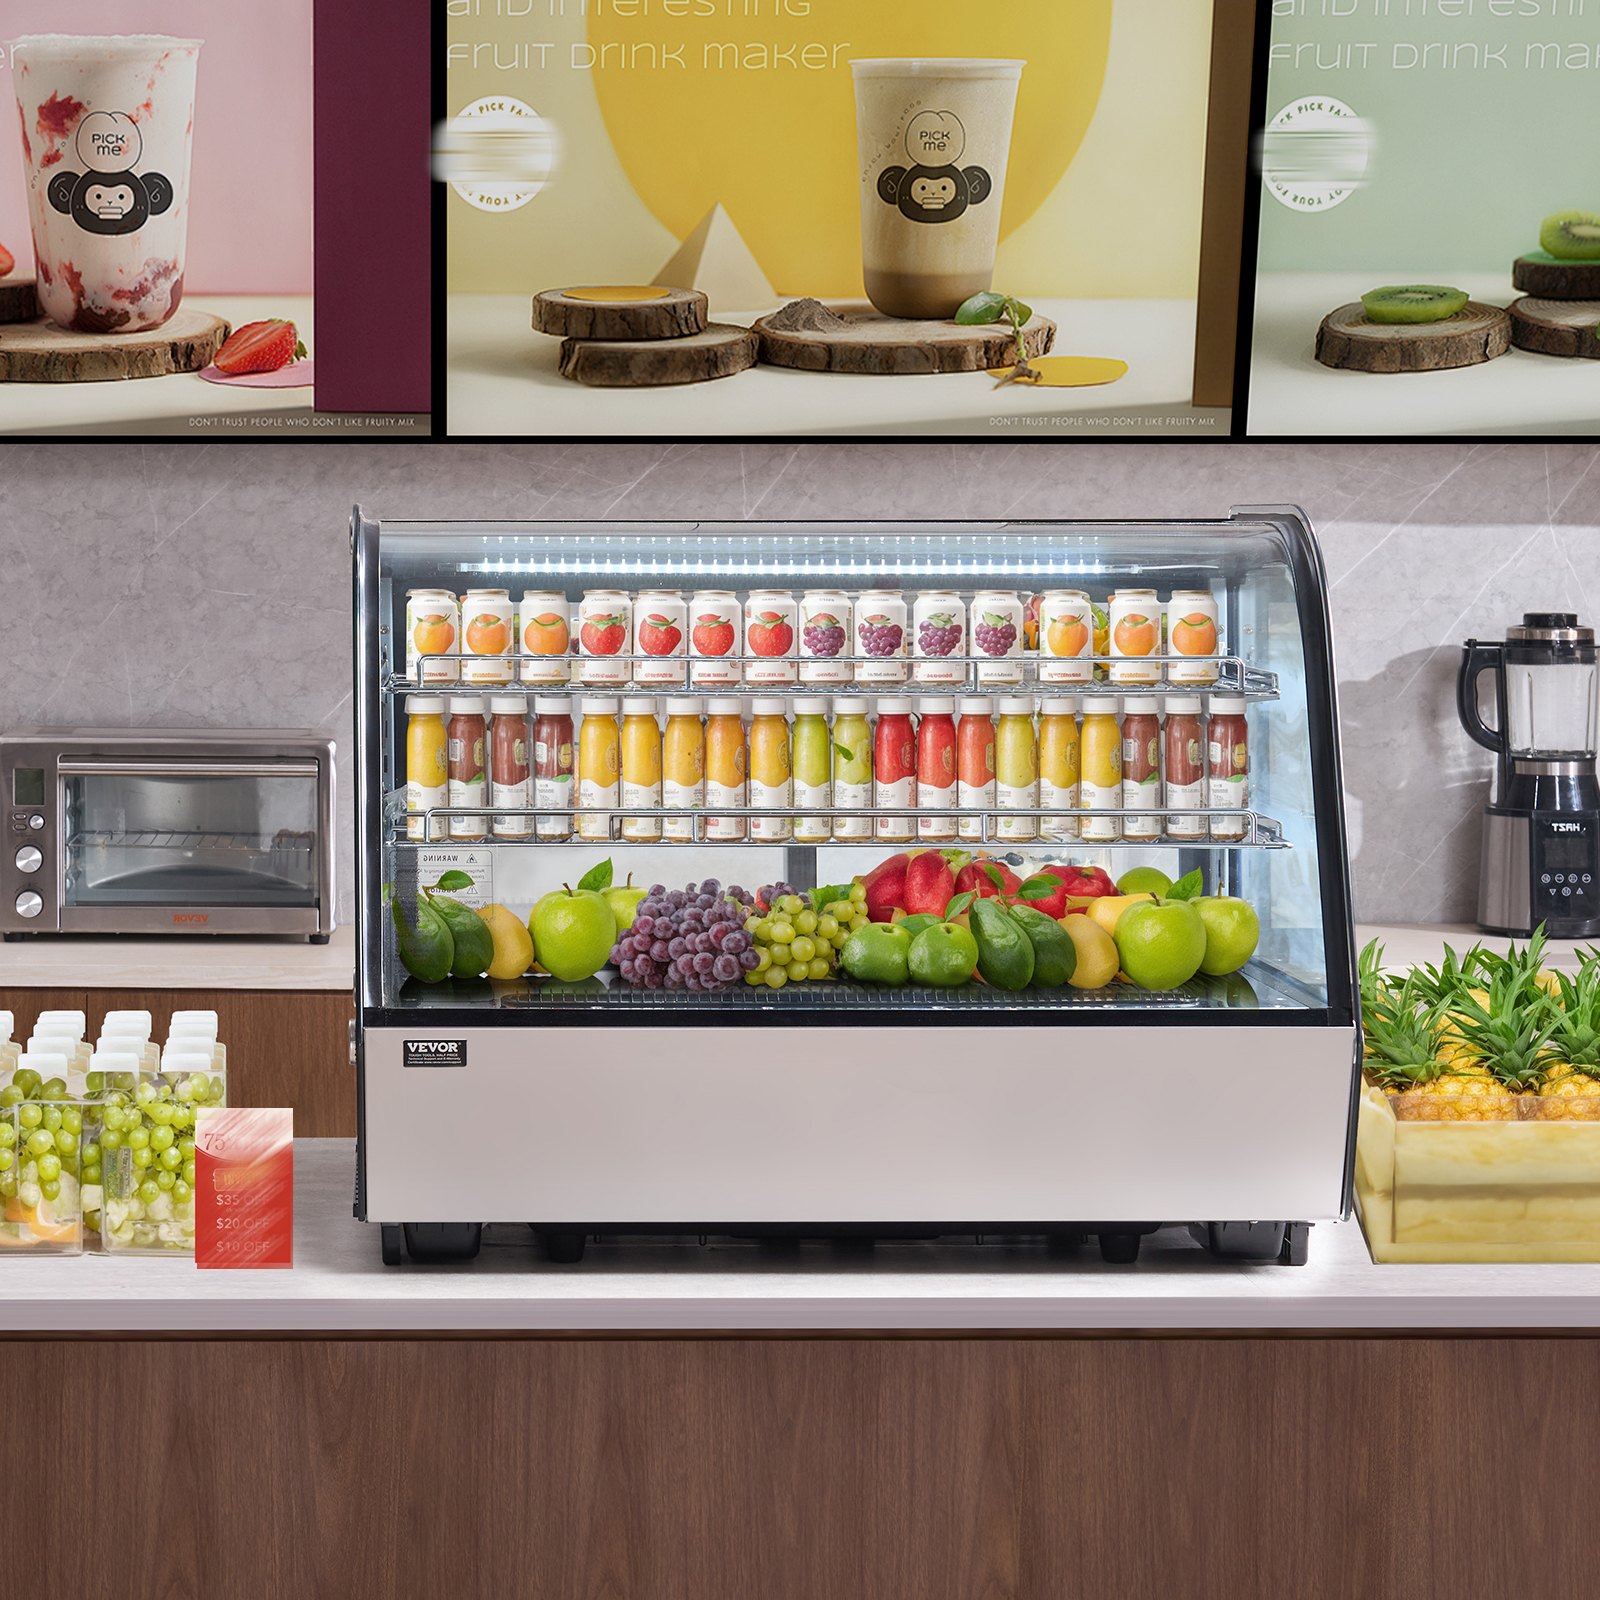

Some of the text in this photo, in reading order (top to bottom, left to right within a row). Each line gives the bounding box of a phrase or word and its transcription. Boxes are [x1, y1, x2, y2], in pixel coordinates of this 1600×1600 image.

[1524, 42, 1600, 70] ma
[1297, 102, 1324, 114] PICK
[91, 133, 126, 145] PICK
[919, 131, 951, 141] PICK
[96, 144, 122, 157] me
[923, 141, 947, 151] me
[189, 417, 415, 427] DON'T TRUST PEOPLE WHO DON'T LIKE FRUITY MIX
[989, 416, 1216, 426] DON'T TRUST PEOPLE WHO DON'T LIKE FRUITY MIX
[407, 1042, 458, 1053] VEVOR
[216, 1194, 240, 1206] $35
[216, 1217, 240, 1229] $20
[216, 1240, 270, 1252] $10 OFF
